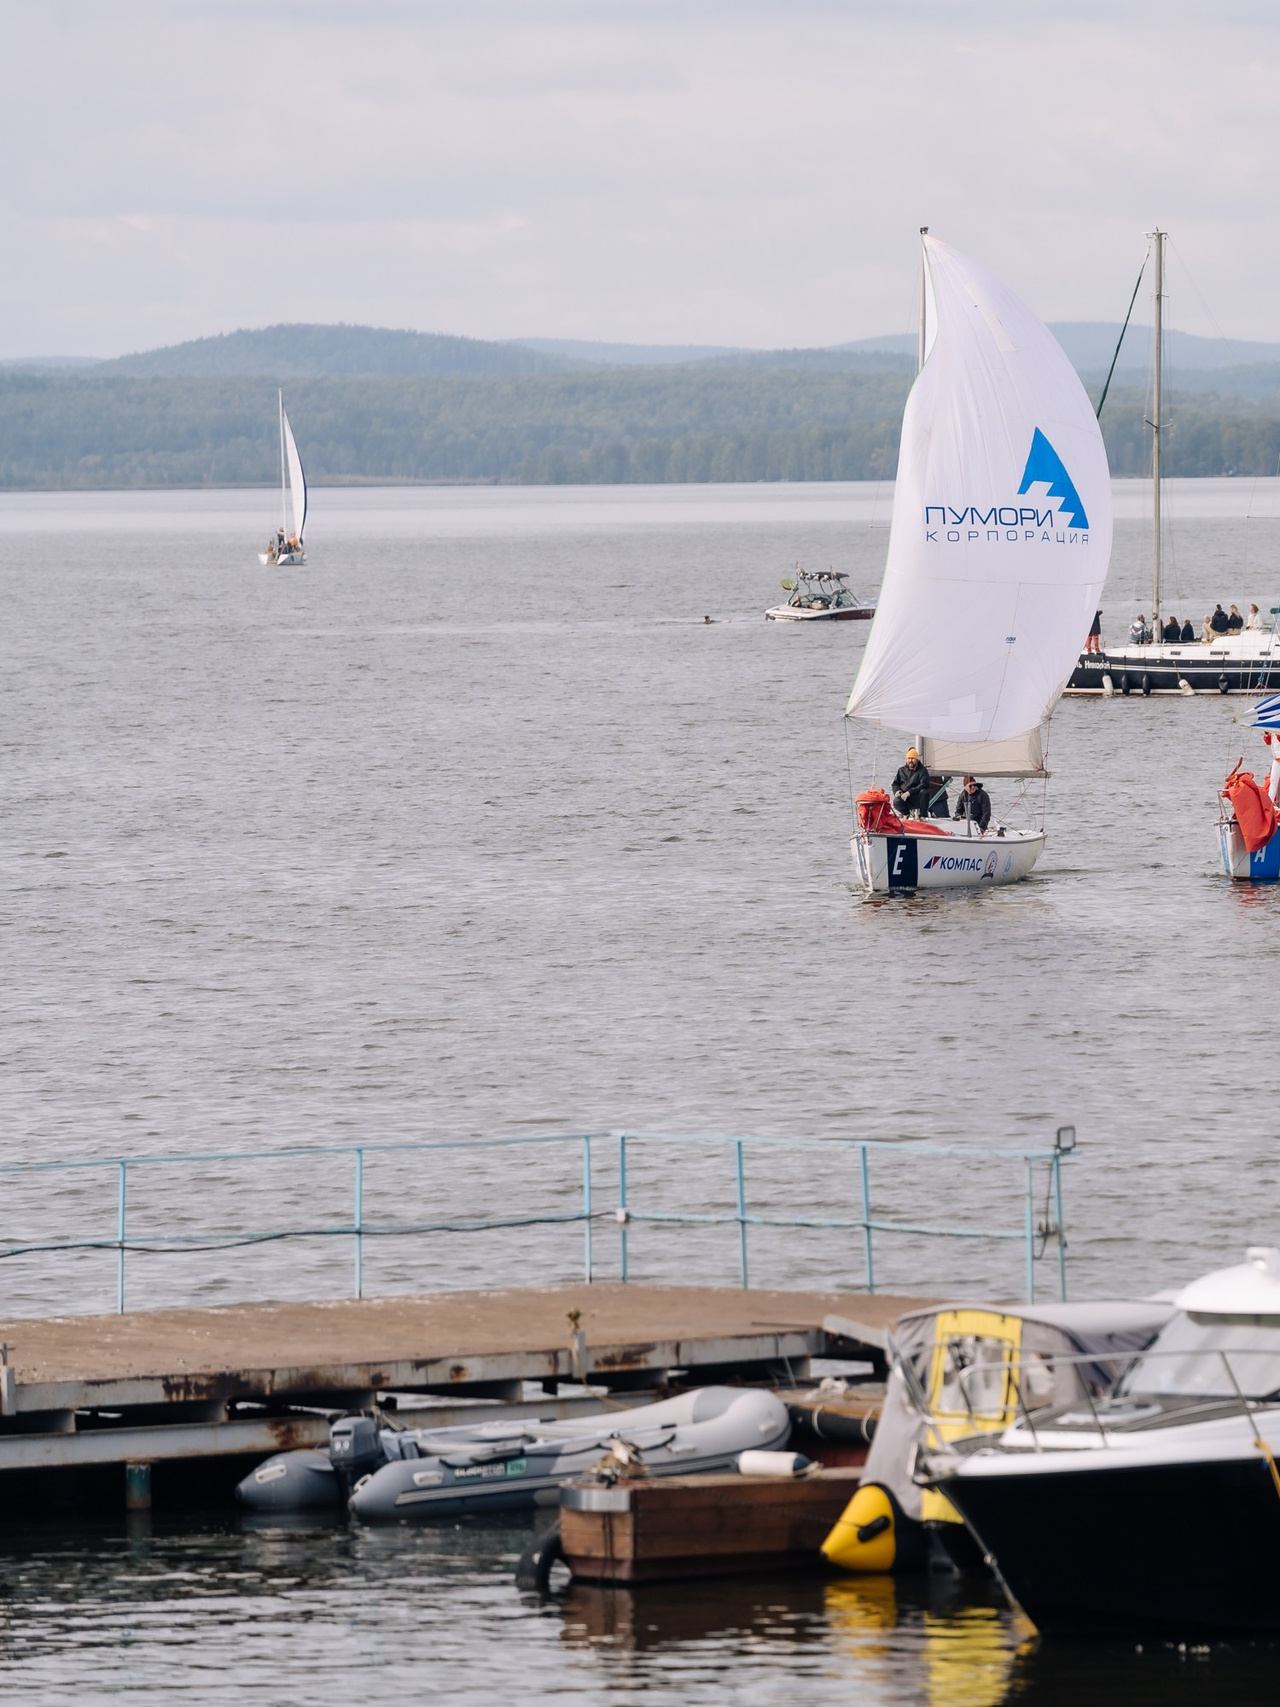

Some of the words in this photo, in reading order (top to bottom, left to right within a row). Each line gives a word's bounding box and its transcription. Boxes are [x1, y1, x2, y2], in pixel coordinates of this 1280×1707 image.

[925, 506, 1054, 528] ПУМОРИ
[926, 530, 1089, 545] КОРПОРАЦИЯ
[892, 845, 907, 875] E
[940, 857, 983, 872] КОМПАС
